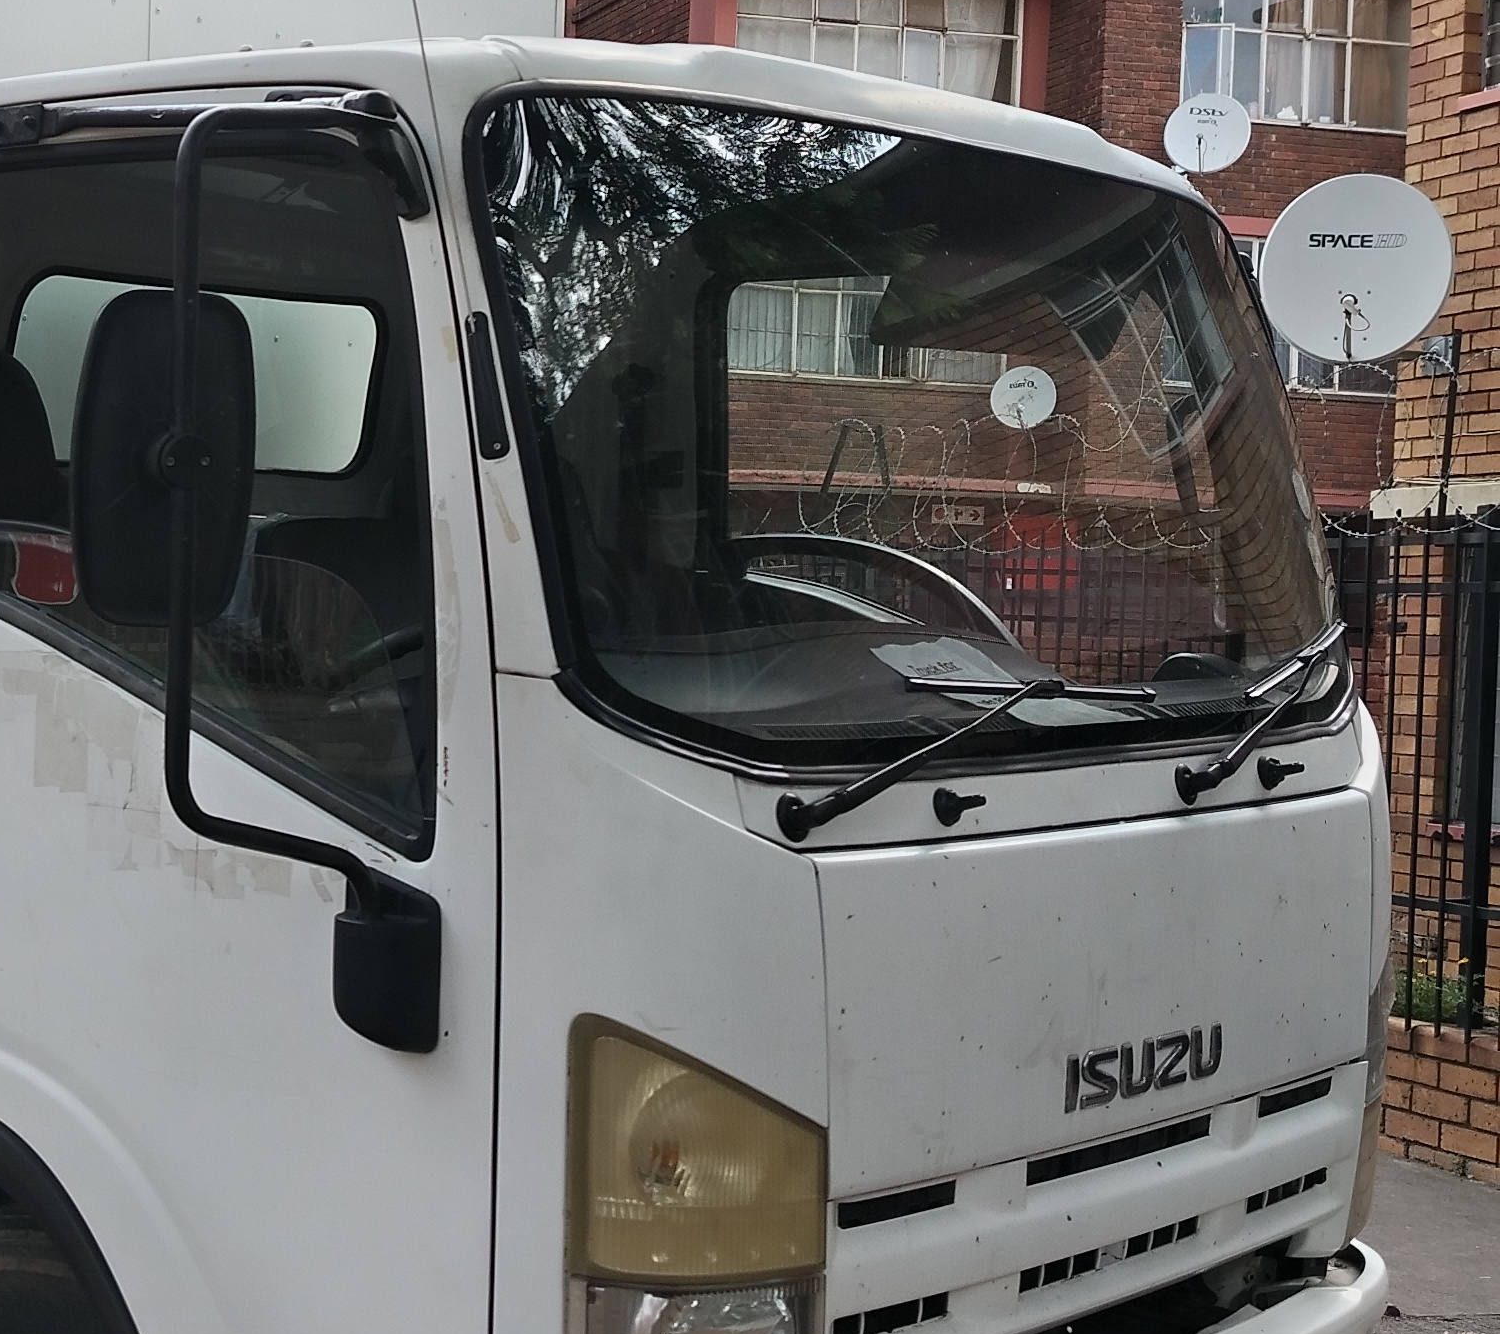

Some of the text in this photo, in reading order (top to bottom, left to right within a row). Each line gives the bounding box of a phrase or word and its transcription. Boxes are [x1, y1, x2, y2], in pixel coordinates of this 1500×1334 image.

[1189, 107, 1229, 117] DStv
[1308, 233, 1373, 248] SPACE
[1064, 1020, 1223, 1114] ISUZU
